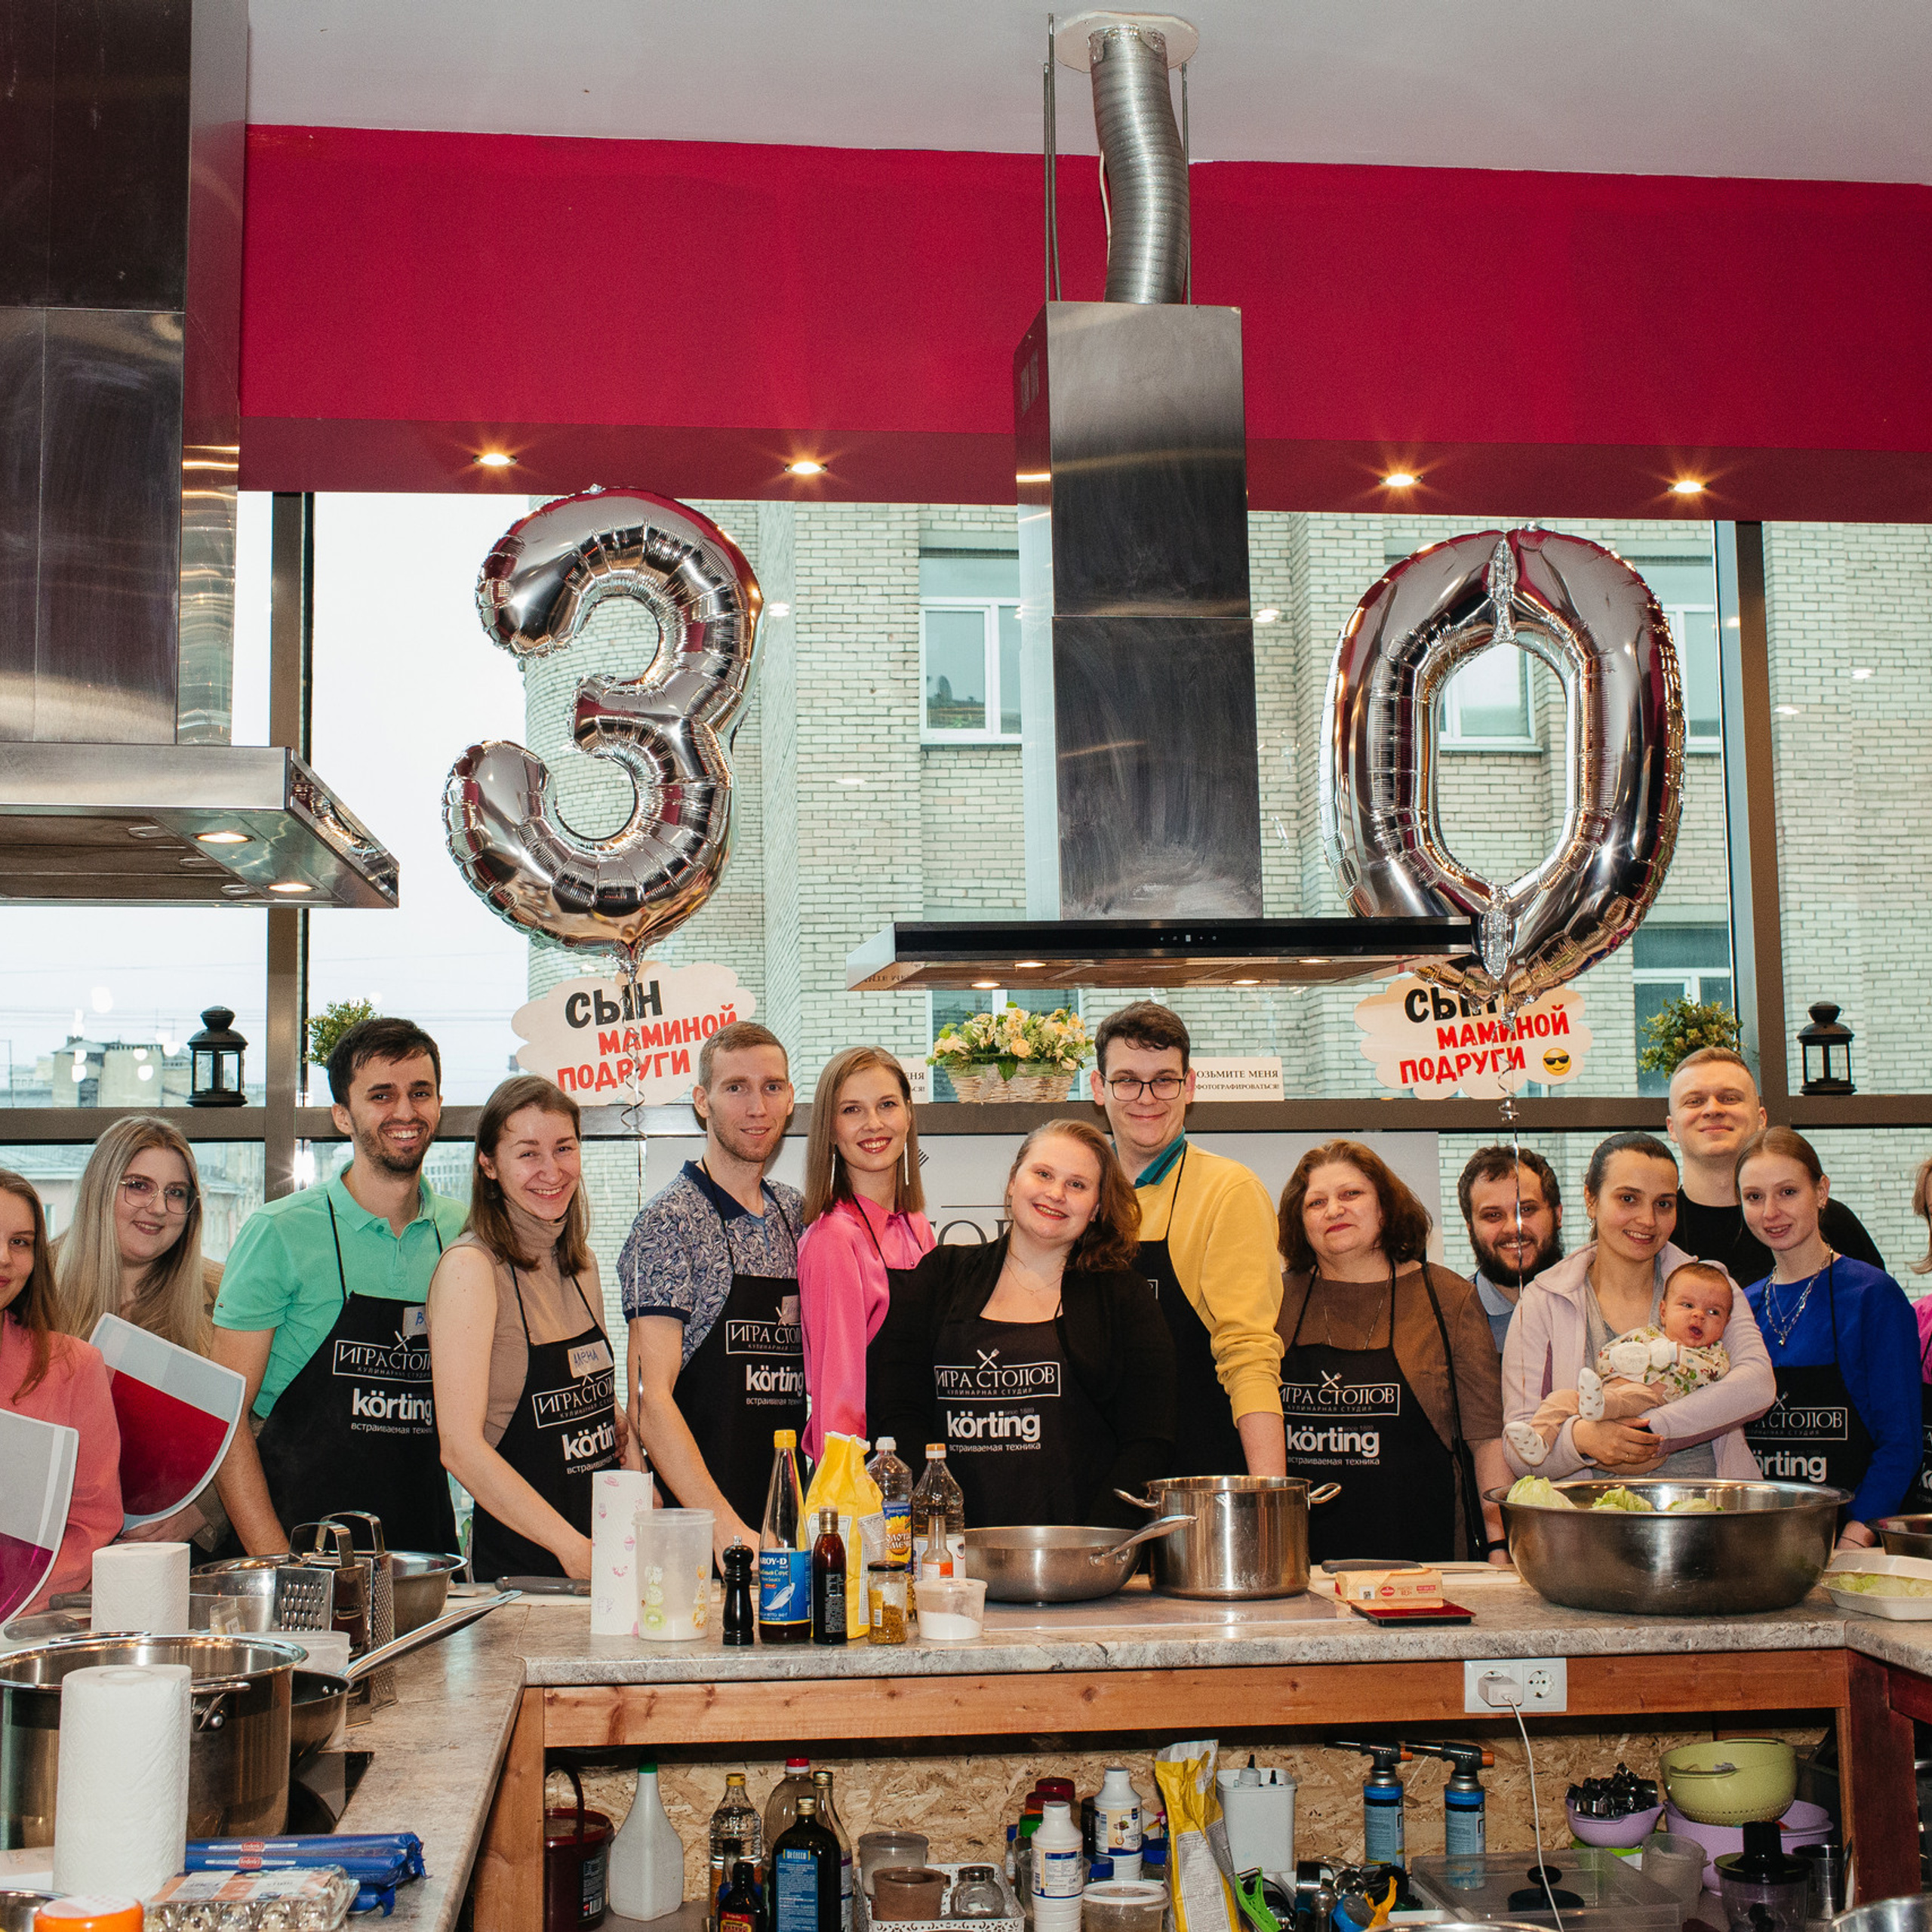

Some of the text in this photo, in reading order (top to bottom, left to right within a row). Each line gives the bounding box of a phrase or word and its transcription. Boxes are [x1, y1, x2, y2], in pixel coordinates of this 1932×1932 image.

[565, 980, 663, 1029] СЫН
[598, 1003, 738, 1057] МАМИНОЙ
[1436, 1004, 1571, 1051] МАМИНОЙ
[557, 1048, 691, 1094] ПОДРУГИ
[1196, 1070, 1278, 1078] ОЗЬМИТЕ МЕНЯ
[1398, 1045, 1527, 1085] ПОДРУГИ
[731, 1324, 770, 1343] ИГРА
[340, 1344, 388, 1367] ИГРА
[746, 1364, 804, 1398] körting
[937, 1367, 1055, 1388] ИГРА СТОЛОВ
[352, 1388, 432, 1426] körting
[538, 1389, 583, 1414] ИГРА
[1318, 1387, 1395, 1404] СТОЛОВ
[946, 1410, 1041, 1442] körting
[1769, 1411, 1843, 1429] СТОЛОВ
[561, 1422, 614, 1461] körtin
[1005, 1441, 1041, 1451] техника
[1286, 1424, 1380, 1458] körting
[1346, 1457, 1380, 1466] техника
[1752, 1450, 1827, 1483] örting
